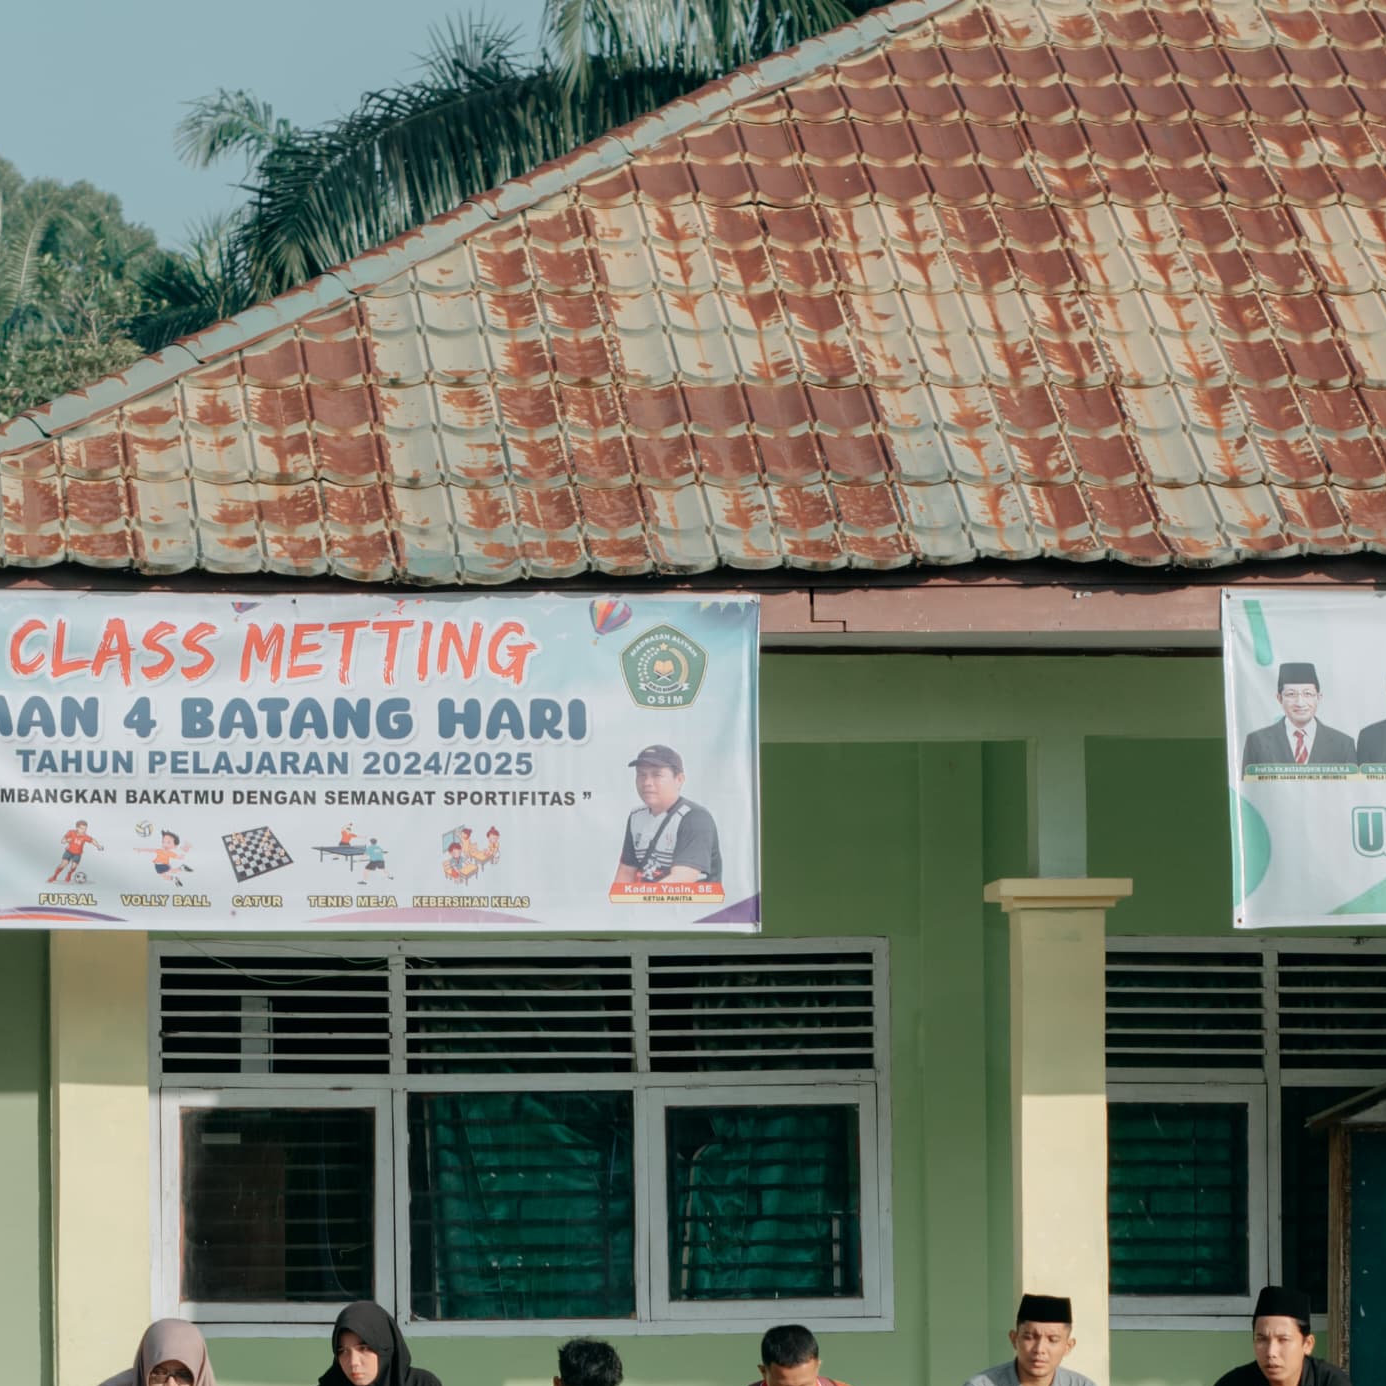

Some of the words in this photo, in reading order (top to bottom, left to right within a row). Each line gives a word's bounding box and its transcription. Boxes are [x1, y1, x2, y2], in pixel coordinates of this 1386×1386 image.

[10, 618, 217, 687] CLASS
[240, 620, 537, 686] METTING
[647, 695, 683, 704] OSIM
[124, 697, 156, 738] 4
[181, 697, 414, 740] BATANG
[437, 698, 587, 740] HARI
[16, 749, 133, 773] TAHUN
[148, 751, 349, 775] PELAJARAN
[363, 752, 533, 776] 2024/2025
[125, 789, 224, 805] BAKATMU
[232, 790, 316, 805] DENGAN
[324, 790, 436, 806] SEMANGAT
[443, 791, 576, 806] SPORTIFITAS
[624, 885, 656, 893] Kadar
[660, 885, 695, 895] Yasin,
[698, 885, 712, 893] SE
[39, 893, 97, 905] FUTSAL
[120, 895, 168, 906] VOLLY
[172, 895, 211, 907] BALL
[232, 895, 283, 907] CATUR
[308, 896, 353, 907] TENIS
[356, 896, 397, 907] MEJA
[412, 896, 489, 907] KEBERSIHAN
[491, 896, 531, 907] KELAS
